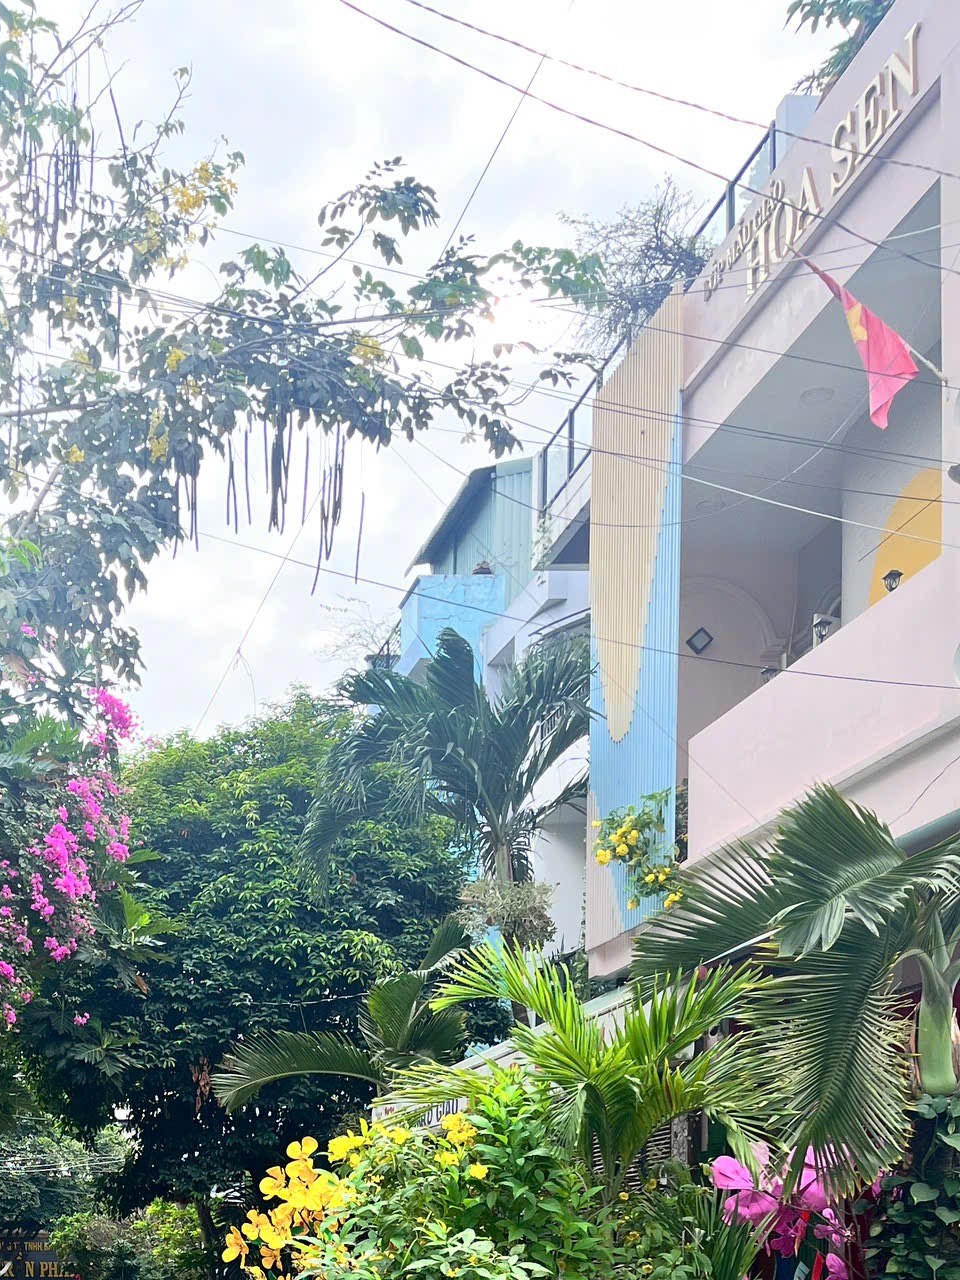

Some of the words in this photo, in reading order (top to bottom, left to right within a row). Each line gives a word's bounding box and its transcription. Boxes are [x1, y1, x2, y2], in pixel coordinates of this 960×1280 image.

[744, 166, 823, 304] HOA
[830, 21, 922, 196] SEN
[24, 1241, 41, 1251] TNHH
